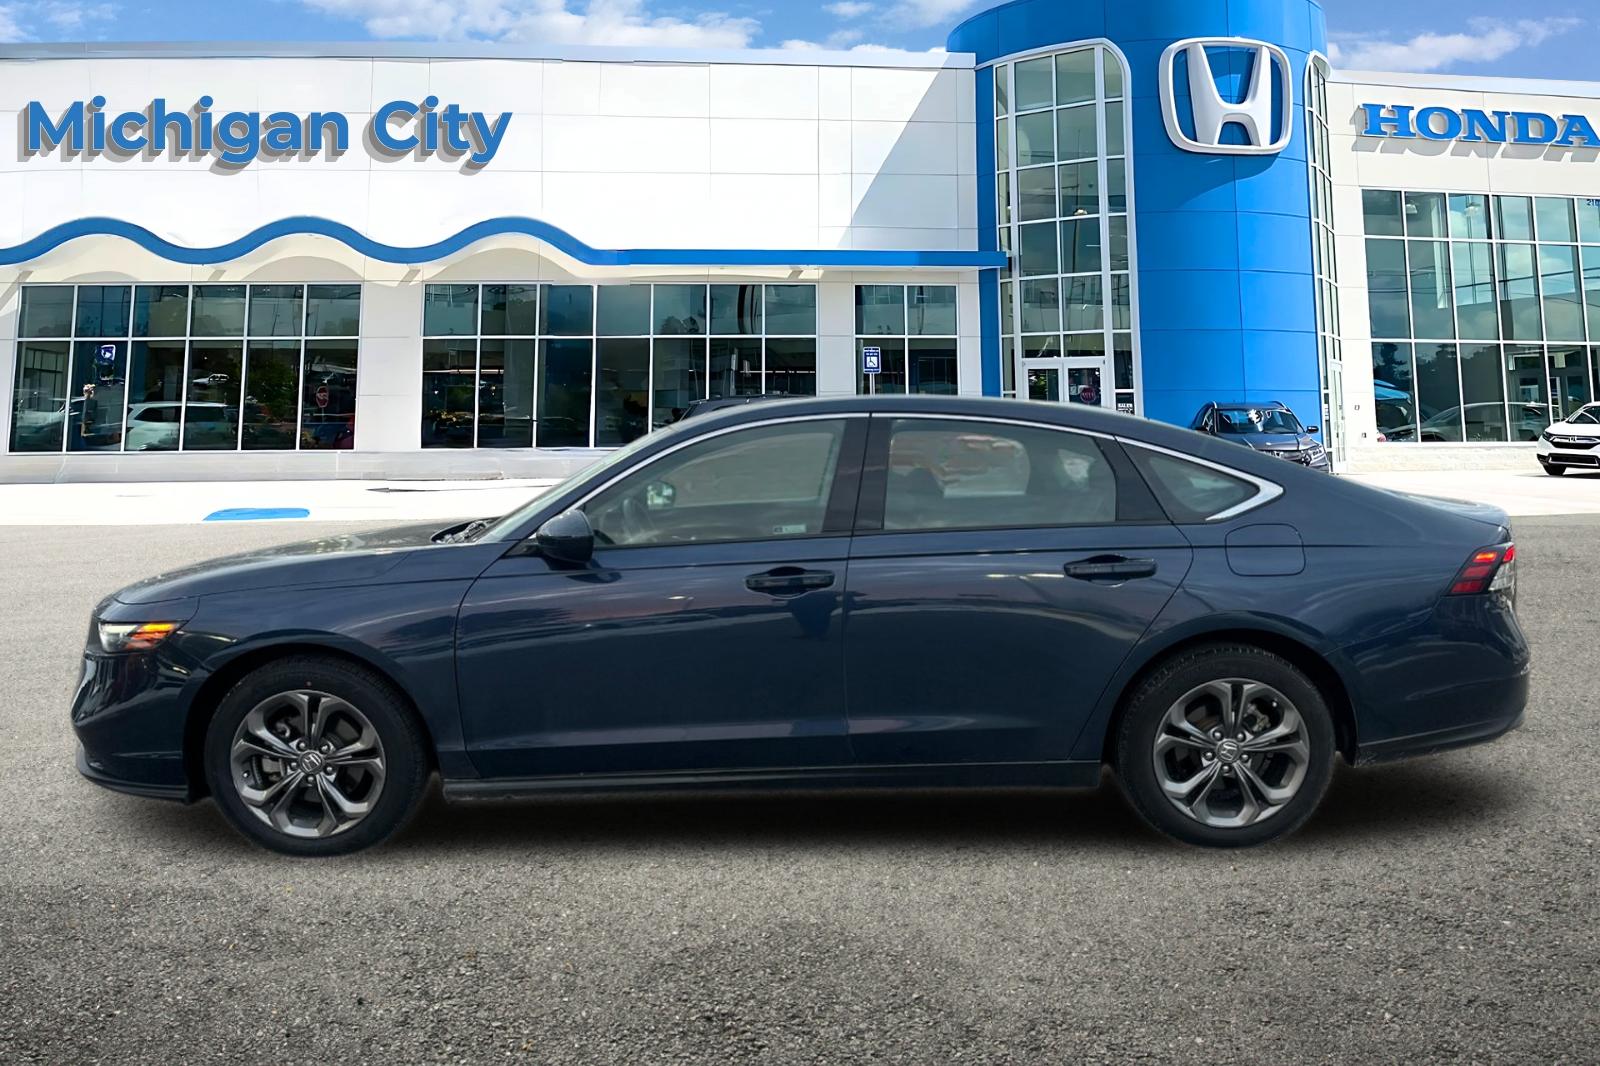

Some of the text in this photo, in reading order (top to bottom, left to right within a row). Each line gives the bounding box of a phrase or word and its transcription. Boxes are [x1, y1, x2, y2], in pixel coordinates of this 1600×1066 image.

[28, 94, 513, 164] Michigan City
[1361, 103, 1600, 148] HONDA
